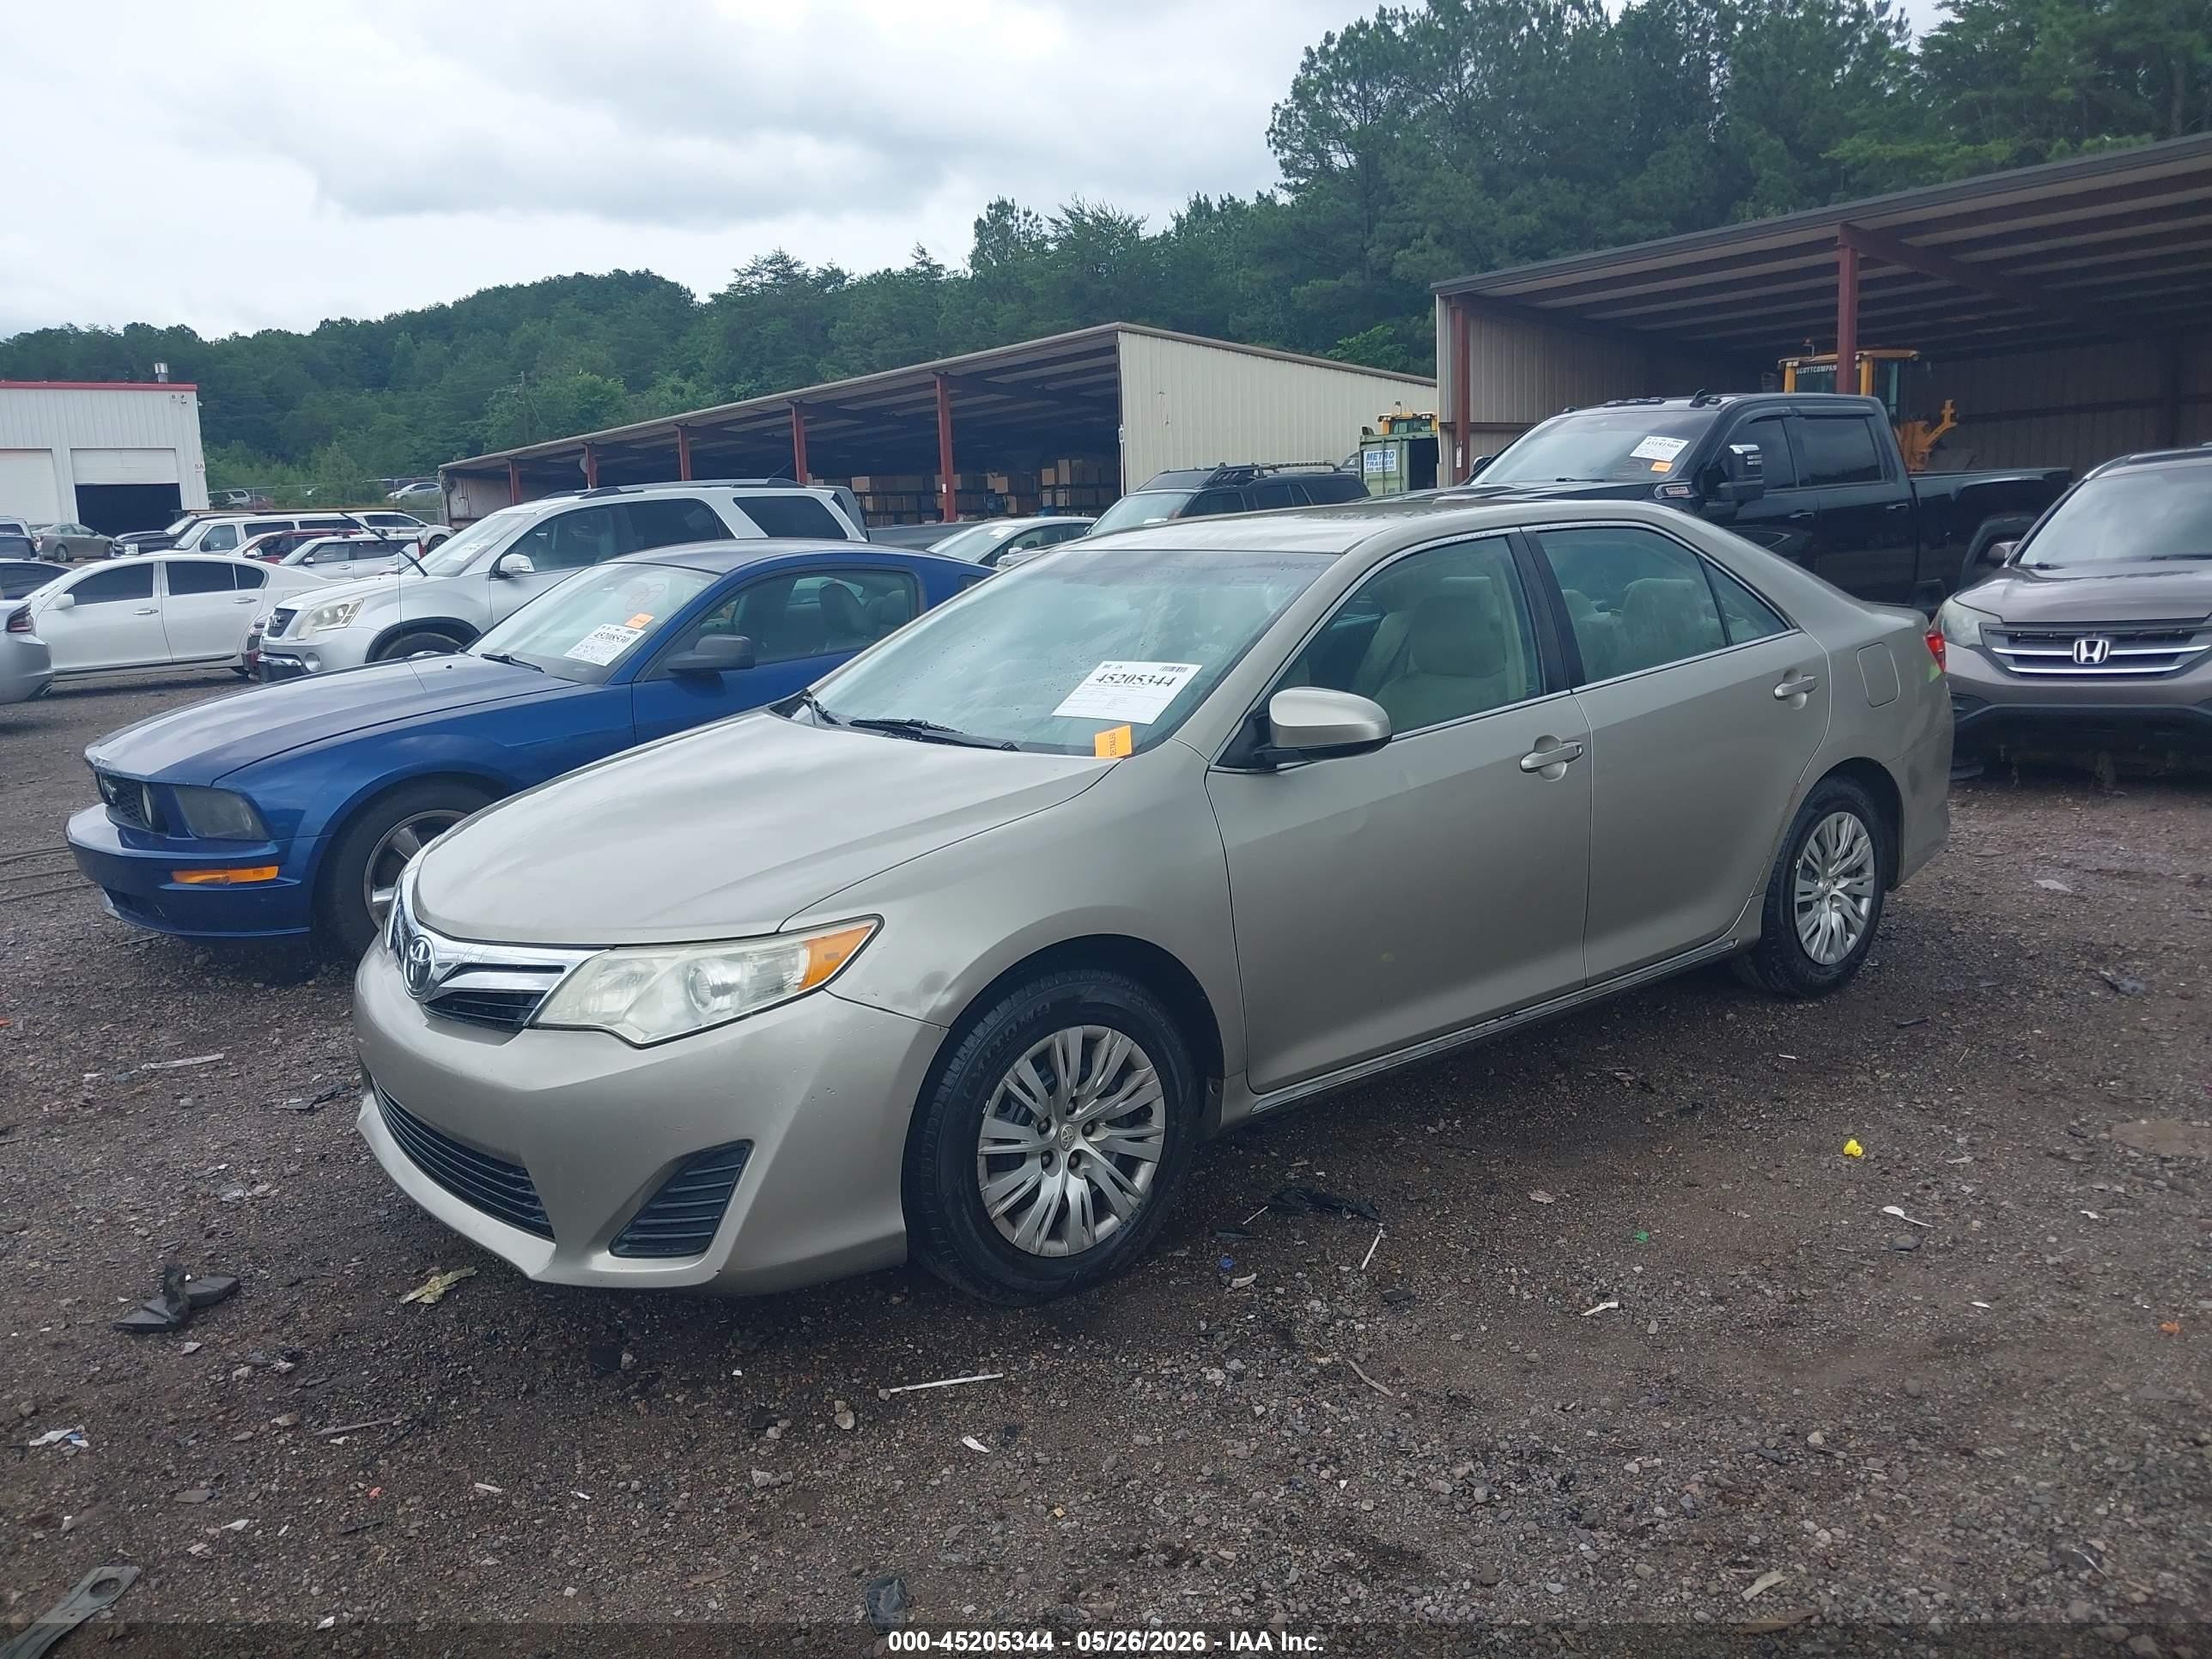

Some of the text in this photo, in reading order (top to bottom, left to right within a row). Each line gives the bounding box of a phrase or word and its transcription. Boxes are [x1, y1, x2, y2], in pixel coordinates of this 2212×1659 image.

[1796, 364, 1838, 375] SCOTTCOMPAN
[1366, 451, 1395, 460] METRO
[1096, 673, 1177, 687] 45205344
